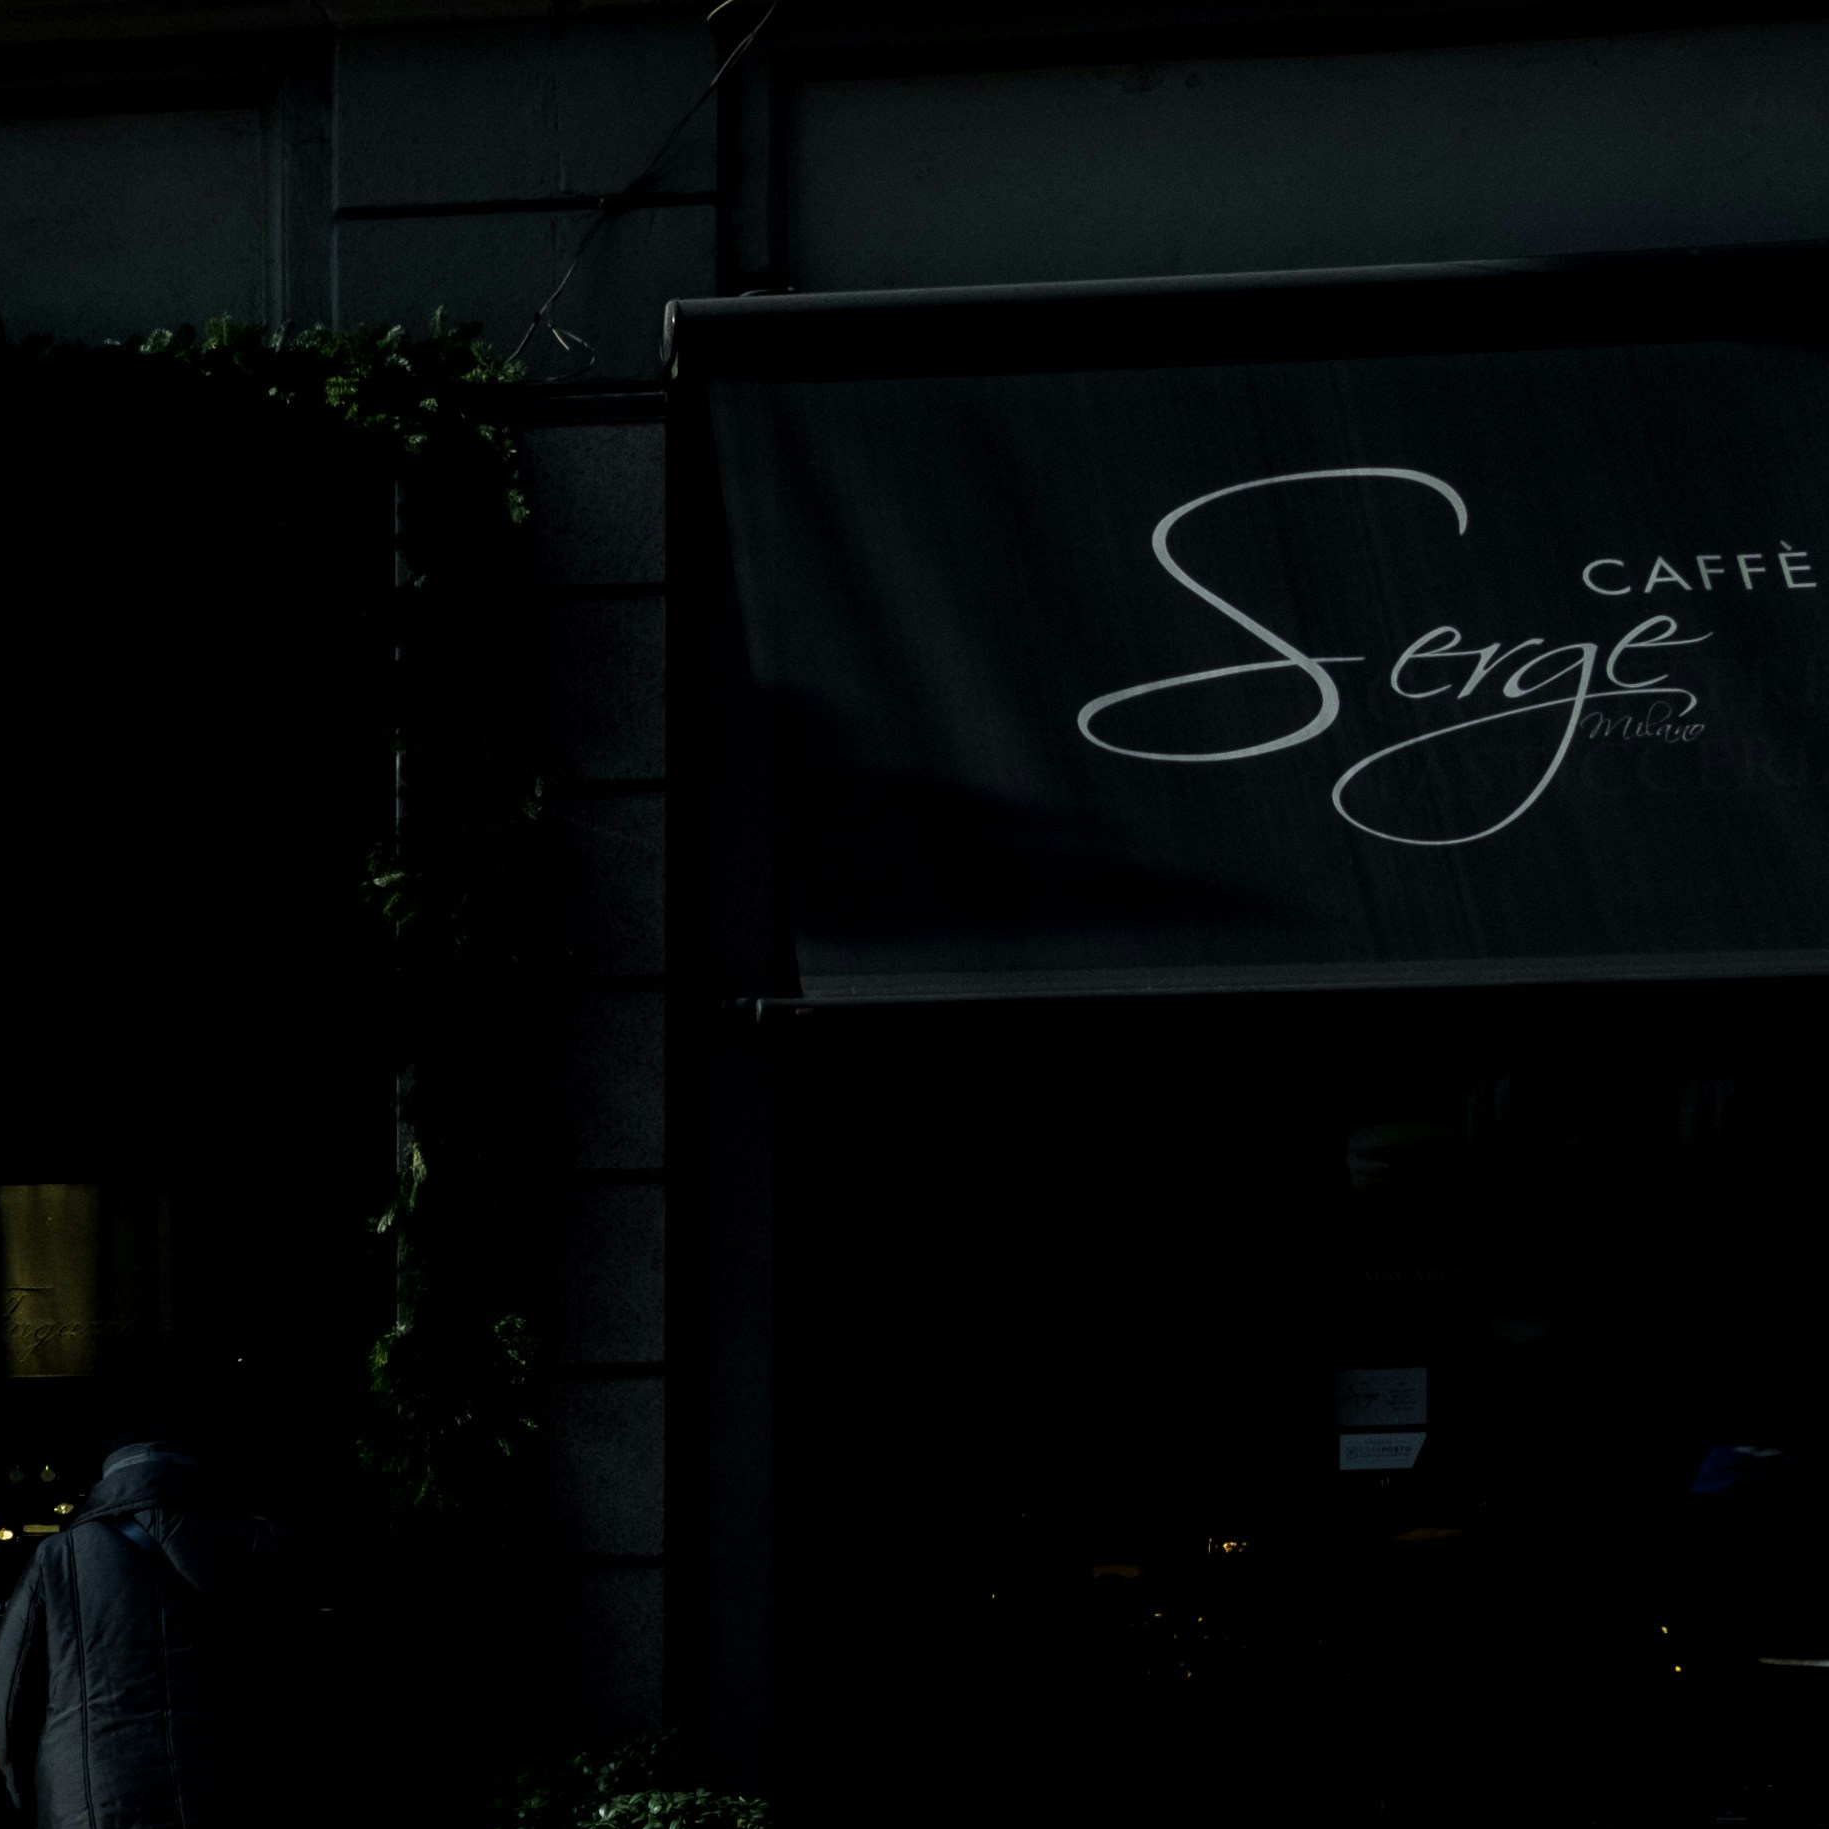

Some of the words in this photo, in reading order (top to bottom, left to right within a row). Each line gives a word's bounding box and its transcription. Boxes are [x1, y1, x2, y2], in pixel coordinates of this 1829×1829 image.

[1582, 541, 1818, 597] CAFFÈ
[1077, 466, 1713, 846] Serge
[1579, 700, 1706, 744] Milano
